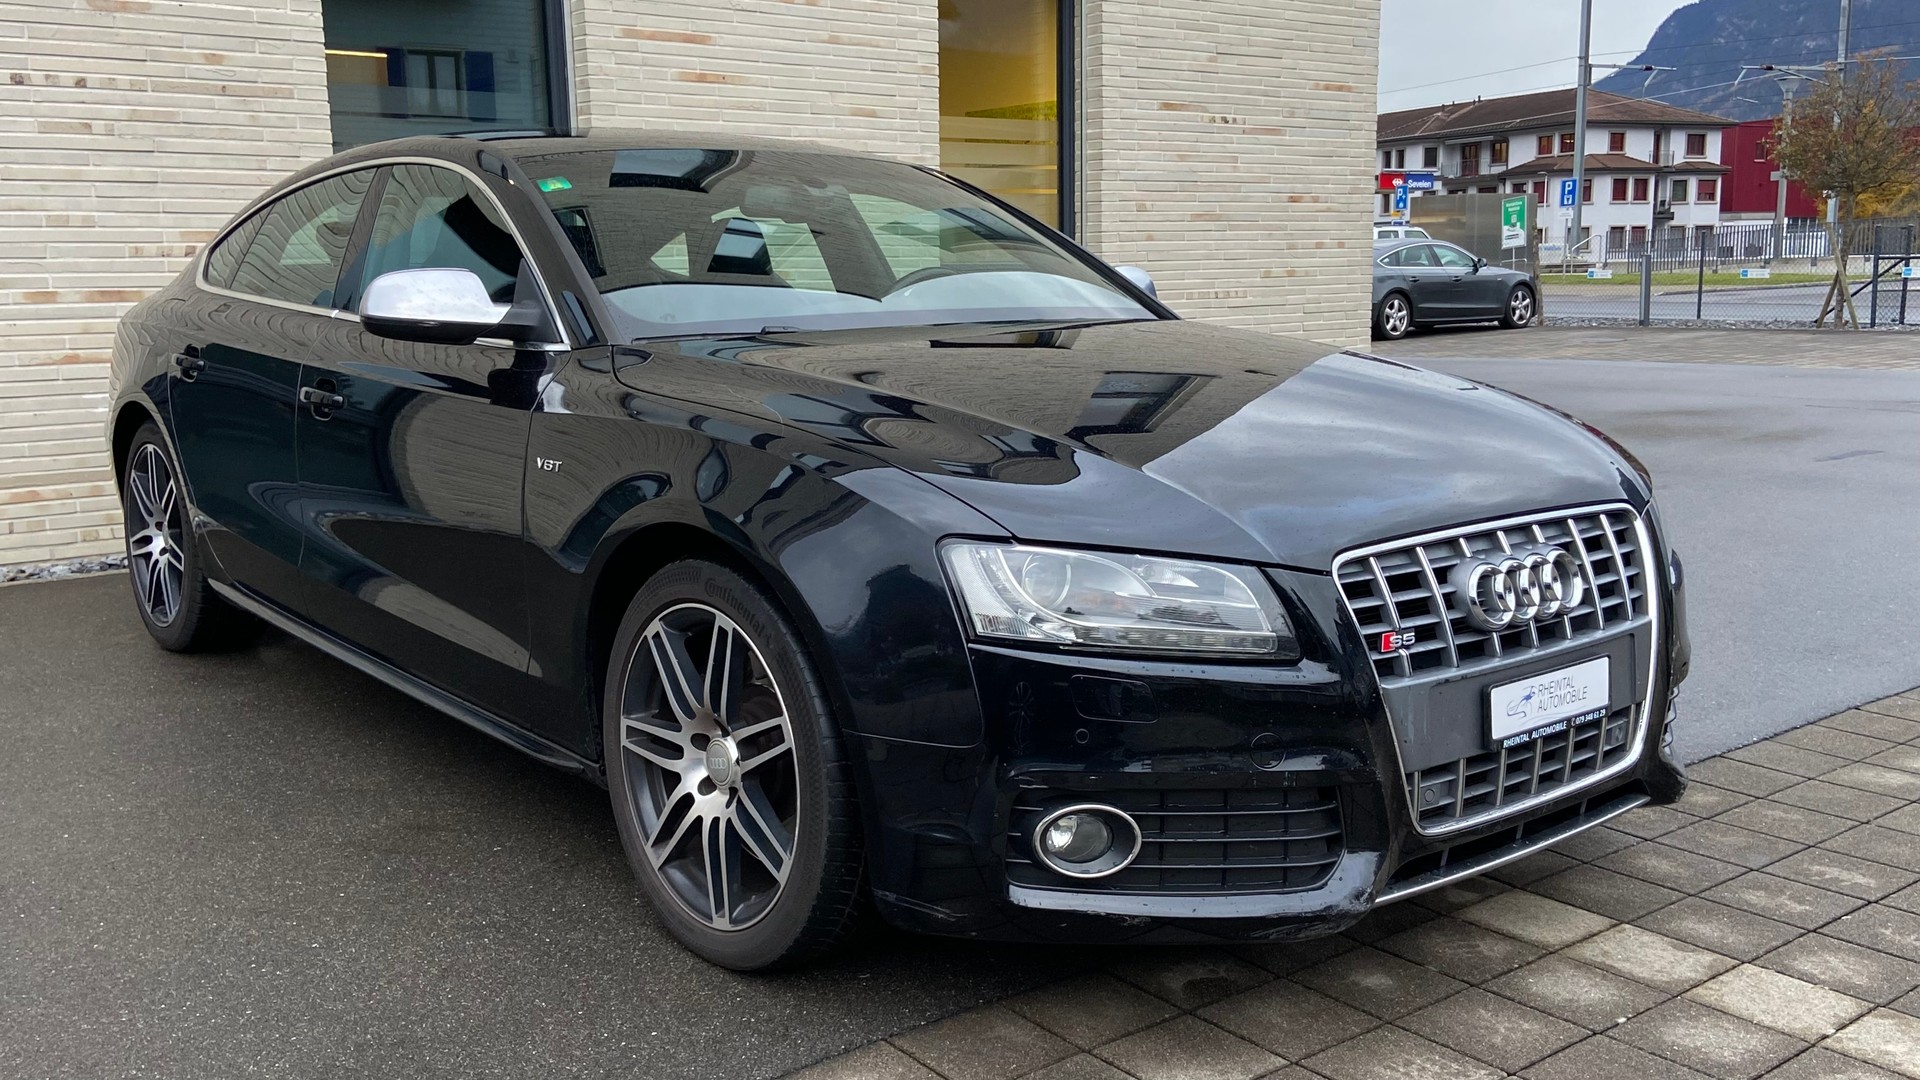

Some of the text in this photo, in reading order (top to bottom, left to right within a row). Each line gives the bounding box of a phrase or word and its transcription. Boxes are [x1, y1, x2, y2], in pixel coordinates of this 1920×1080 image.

[1407, 179, 1432, 188] Sevelen
[1565, 181, 1573, 195] P
[536, 456, 563, 472] V6T
[704, 577, 766, 637] Continental
[1389, 632, 1416, 647] S5
[1538, 676, 1575, 697] RHEINTAL
[1537, 686, 1588, 712] AUTOMOBILE
[1503, 733, 1530, 748] RHEINTAL
[1531, 721, 1567, 739] AUTOMOBILE
[1575, 715, 1585, 725] 079
[1599, 708, 1606, 717] 29
